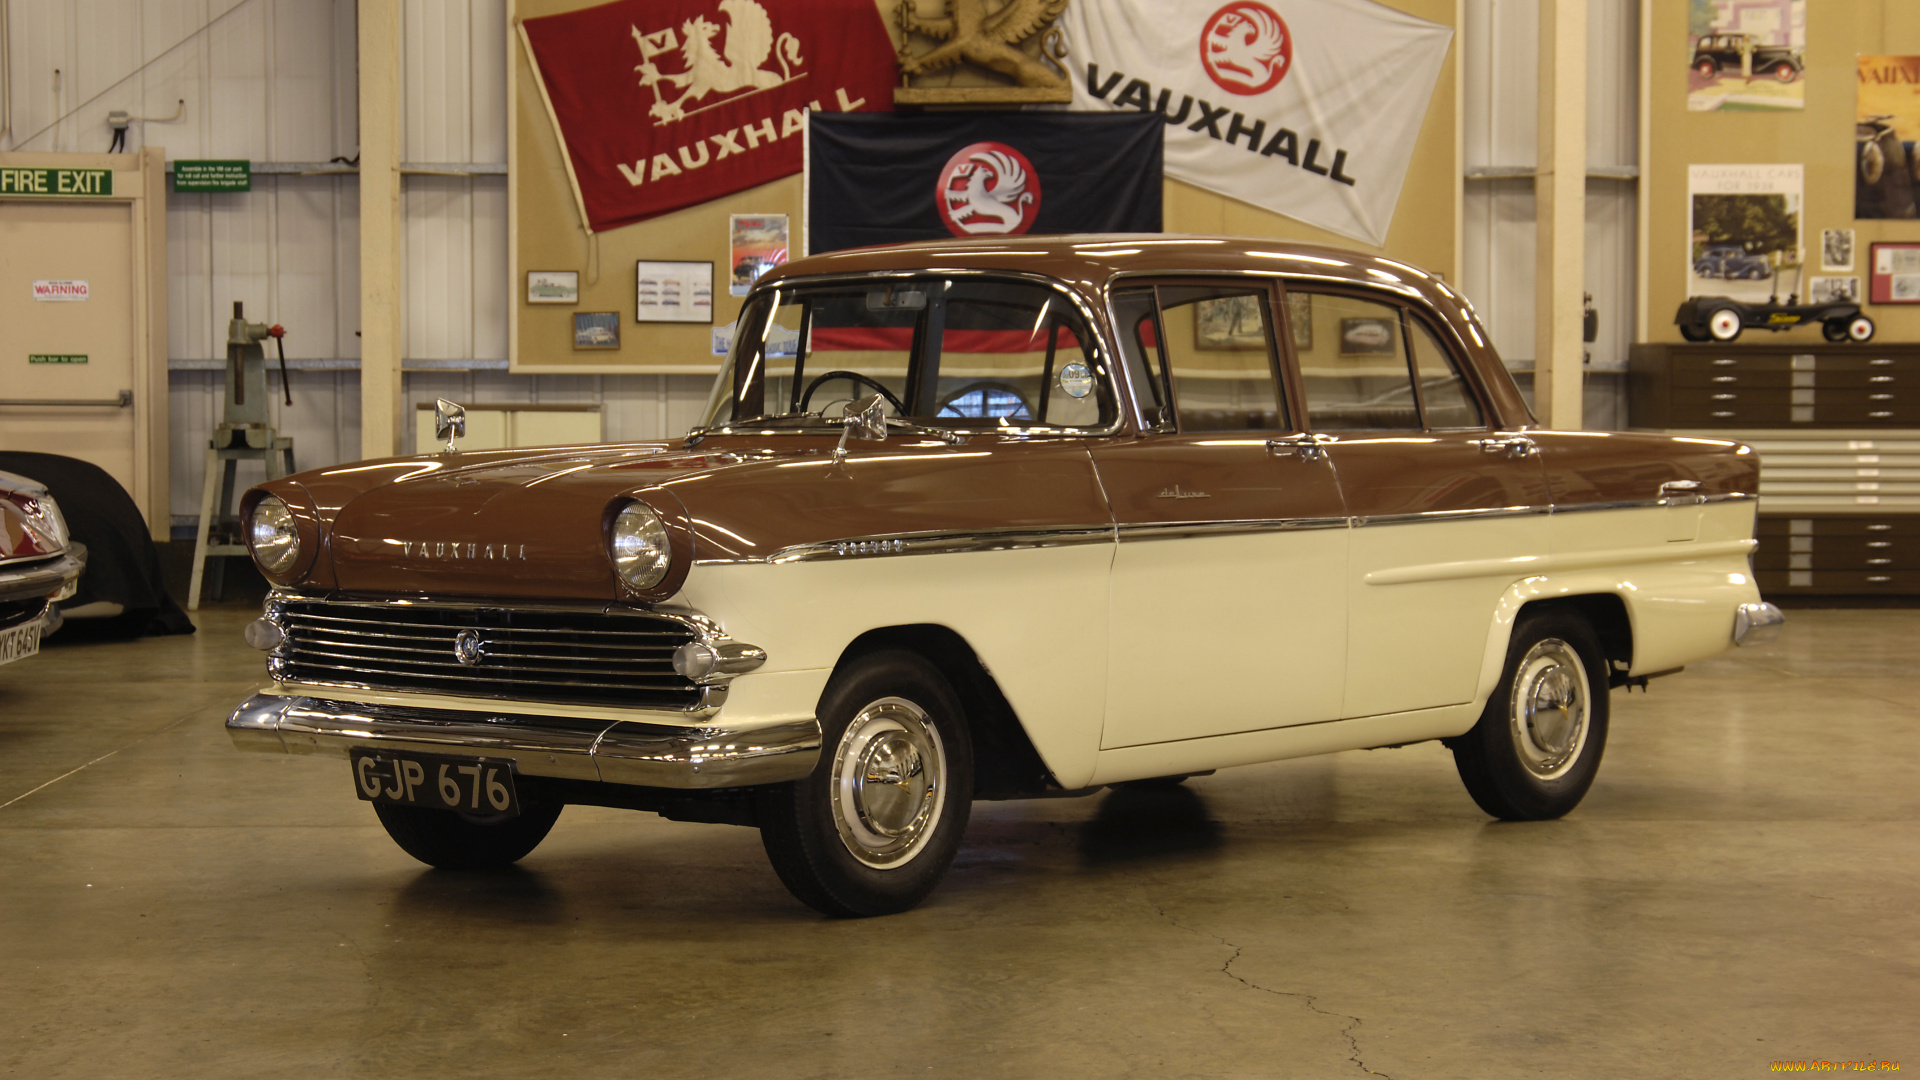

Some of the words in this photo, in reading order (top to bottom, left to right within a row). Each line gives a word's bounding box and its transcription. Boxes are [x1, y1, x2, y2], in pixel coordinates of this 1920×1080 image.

[648, 32, 667, 50] V
[1087, 62, 1356, 187] VAUXHALL
[616, 87, 866, 187] VAUXHAL
[1, 169, 48, 192] FIRE
[58, 170, 105, 193] EXIT
[1691, 168, 1762, 179] VAUXHALL
[35, 285, 87, 295] WARNING
[403, 541, 526, 561] VAUXHALL
[17, 624, 40, 656] 645V
[358, 756, 424, 802] GJP
[438, 763, 510, 811] 676
